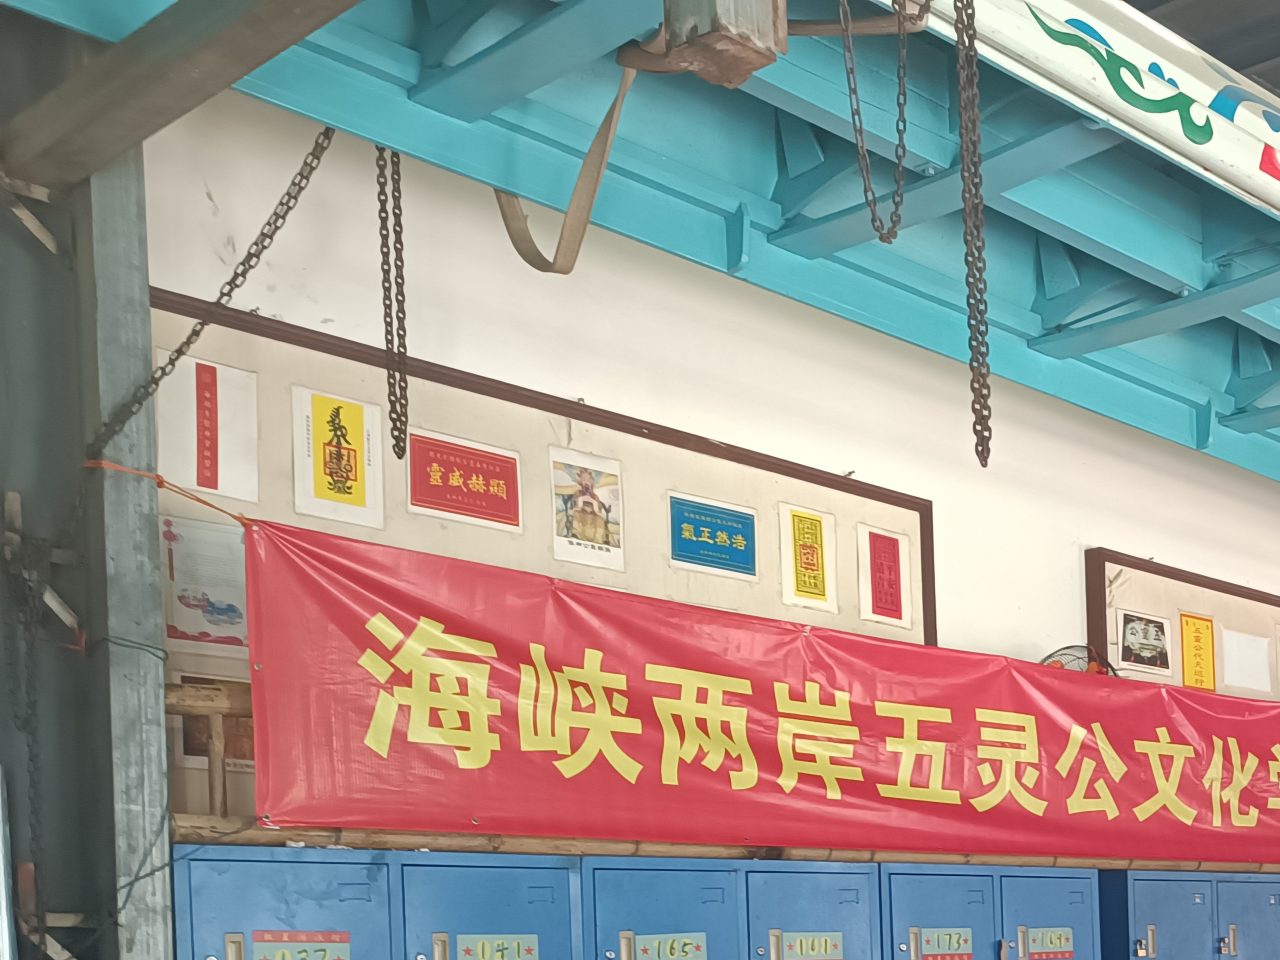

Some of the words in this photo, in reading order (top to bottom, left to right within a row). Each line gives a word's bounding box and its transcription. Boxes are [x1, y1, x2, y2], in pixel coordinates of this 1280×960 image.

[480, 940, 521, 960] 141
[657, 938, 693, 960] 165
[936, 932, 962, 951] 173
